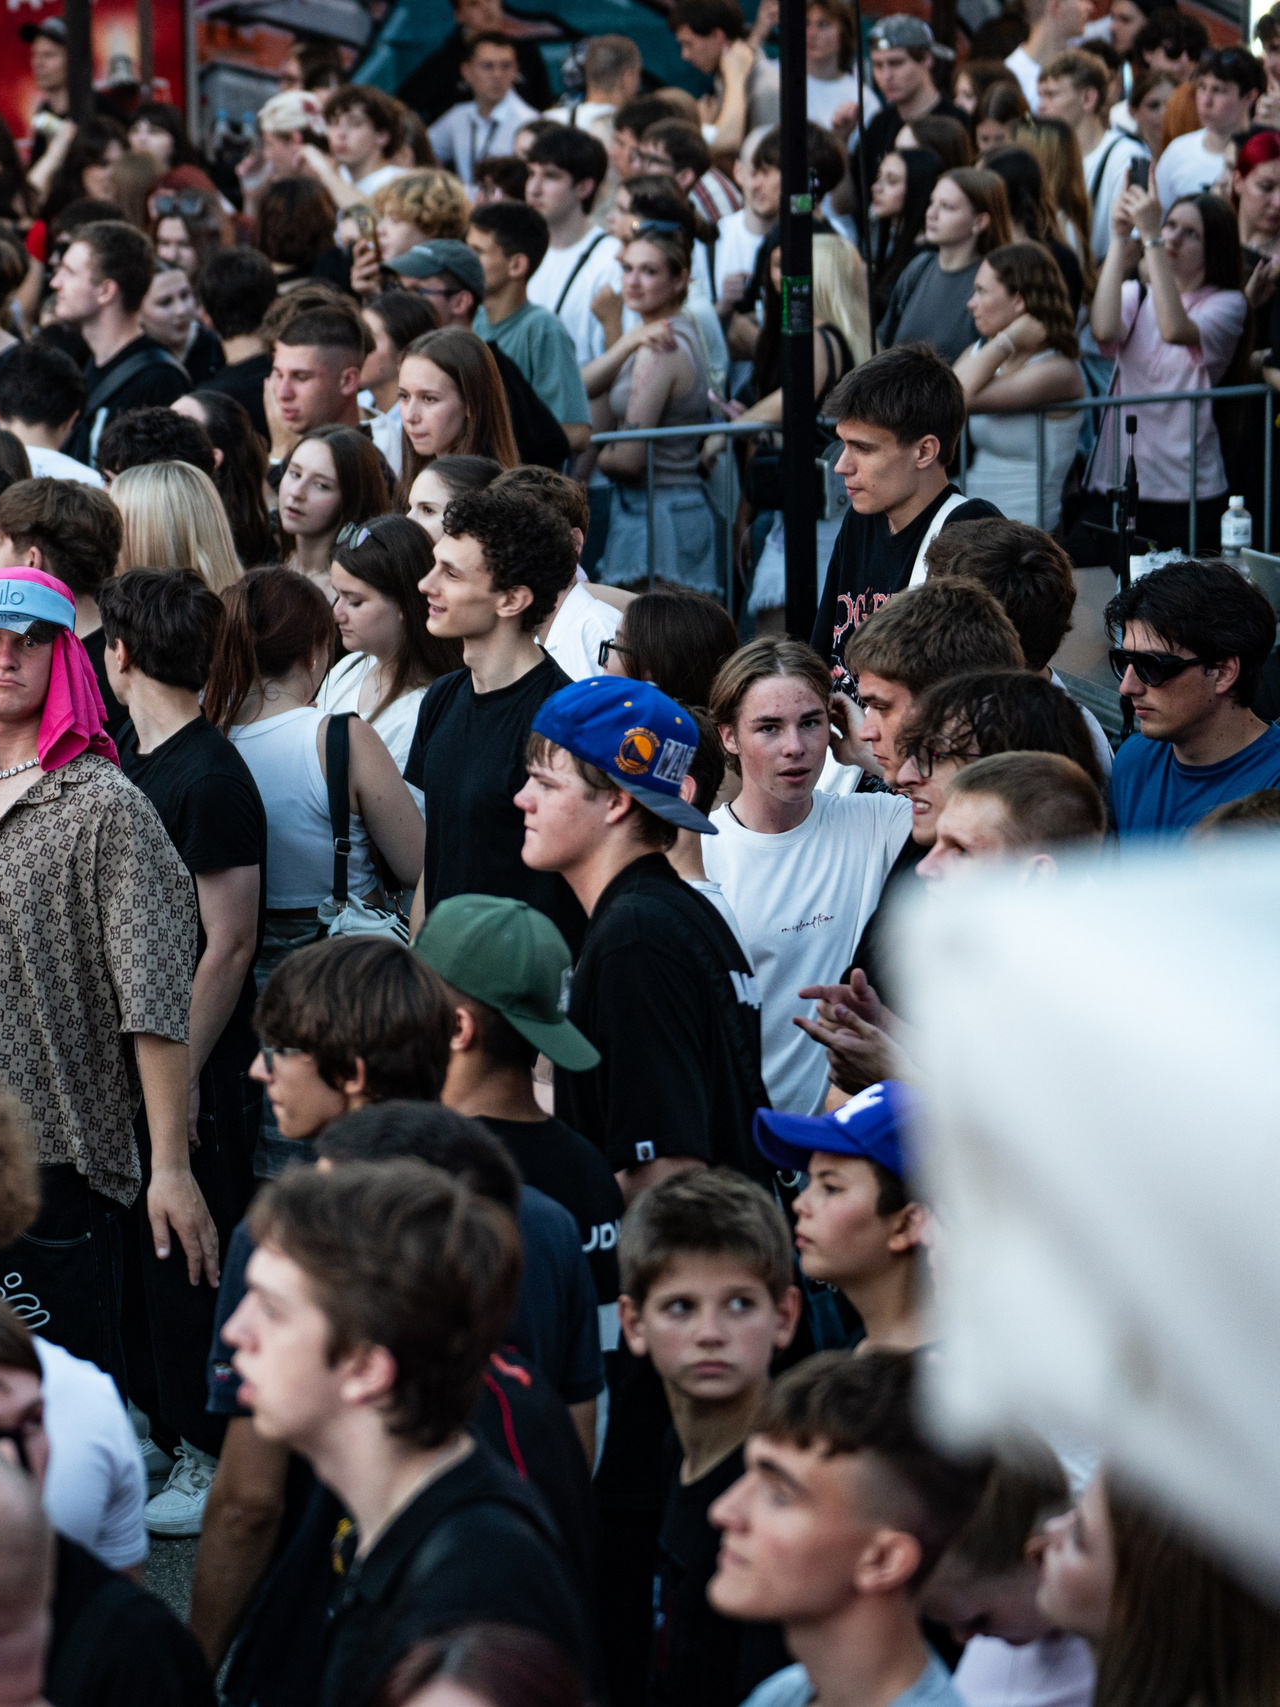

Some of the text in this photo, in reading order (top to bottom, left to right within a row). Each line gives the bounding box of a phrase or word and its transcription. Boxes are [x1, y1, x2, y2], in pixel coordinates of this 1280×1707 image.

[69, 761, 82, 772] 69
[85, 755, 100, 764] 69
[28, 785, 43, 799] 69
[87, 784, 104, 798] 69
[107, 782, 124, 795] 69
[69, 793, 84, 806] 69
[108, 798, 123, 817] 69
[50, 802, 66, 816] 69
[74, 808, 87, 824] 69
[90, 800, 106, 818] 69
[126, 802, 139, 819] 69
[30, 811, 47, 824] 69
[53, 818, 70, 832] 69
[140, 812, 153, 826] 69
[12, 820, 27, 835] 69
[35, 826, 50, 841] 69
[76, 826, 92, 844] 69
[106, 820, 121, 839] 69
[16, 836, 32, 850] 69
[59, 834, 74, 852] 69
[139, 828, 149, 845] 69
[151, 837, 163, 852] 69
[0, 846, 14, 861] 69
[40, 843, 56, 859] 69
[80, 847, 93, 866] 69
[102, 842, 117, 860] 69
[135, 850, 149, 865] 69
[22, 852, 37, 869] 69
[5, 863, 20, 878] 69
[48, 861, 62, 880] 69
[99, 863, 116, 882] 69
[130, 868, 146, 886] 69
[30, 870, 46, 888] 69
[176, 876, 190, 890] 69
[14, 881, 27, 898] 69
[56, 882, 69, 899] 69
[97, 886, 113, 901] 69
[161, 887, 174, 904] 69
[0, 891, 11, 907] 69
[38, 889, 54, 907] 69
[75, 893, 88, 909] 69
[133, 894, 148, 909] 69
[185, 891, 195, 908] 69
[22, 900, 37, 916] 69
[170, 904, 184, 920] 69
[46, 909, 61, 926] 69
[81, 912, 94, 930] 69
[121, 909, 133, 925] 69
[147, 910, 158, 926] 69
[0, 920, 13, 935] 69
[32, 918, 44, 936] 69
[132, 924, 147, 938] 69
[158, 928, 169, 942] 69
[40, 937, 53, 954] 69
[54, 928, 68, 947] 69
[88, 933, 102, 949] 69
[121, 938, 132, 955] 69
[147, 940, 158, 956] 69
[25, 947, 38, 964] 69
[62, 949, 76, 966] 69
[132, 954, 147, 968] 69
[46, 956, 59, 973] 69
[9, 966, 22, 982] 69
[36, 966, 45, 982] 69
[70, 967, 81, 985] 69
[121, 968, 132, 984] 69
[147, 969, 157, 985] 69
[53, 976, 67, 993] 69
[87, 975, 99, 992] 69
[132, 983, 146, 998] 69
[5, 995, 19, 1012] 69
[59, 994, 74, 1012] 69
[93, 994, 108, 1010] 69
[145, 1000, 156, 1015] 69
[16, 1012, 32, 1028] 69
[66, 1014, 83, 1031] 69
[100, 1012, 115, 1029] 69
[132, 1014, 145, 1028] 69
[2, 1024, 16, 1041] 69
[29, 1029, 43, 1046] 69
[75, 1033, 88, 1049] 69
[12, 1042, 28, 1058] 69
[59, 1042, 72, 1058] 69
[24, 1058, 39, 1076] 69
[66, 1060, 80, 1078] 69
[100, 1059, 114, 1074] 69
[8, 1071, 24, 1086] 69
[35, 1076, 50, 1092] 69
[73, 1080, 87, 1096] 69
[21, 1088, 34, 1105] 69
[47, 1092, 60, 1110] 69
[32, 1106, 46, 1121] 69
[81, 1097, 94, 1115] 69
[43, 1122, 56, 1138] 69
[89, 1116, 102, 1132] 69
[53, 1140, 67, 1154] 69
[109, 1146, 119, 1160] 69
